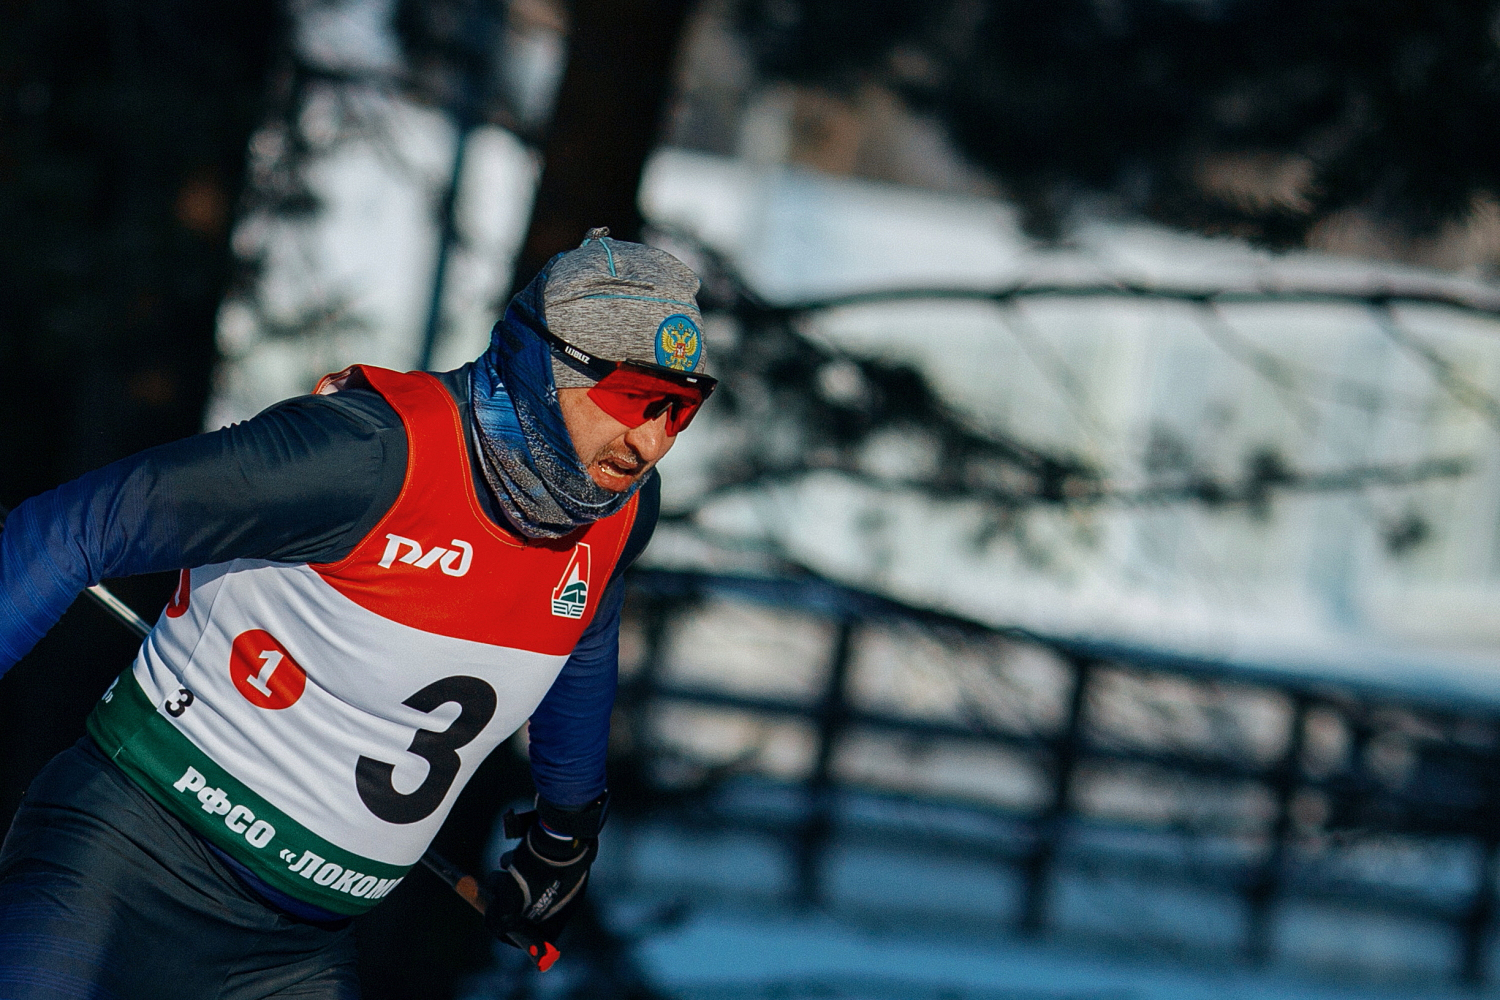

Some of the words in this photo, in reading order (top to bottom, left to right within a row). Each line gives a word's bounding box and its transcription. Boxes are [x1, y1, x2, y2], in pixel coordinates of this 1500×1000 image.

[164, 688, 195, 718] 3
[245, 649, 285, 698] 1
[354, 674, 498, 825] 3
[172, 765, 277, 849] РФСО
